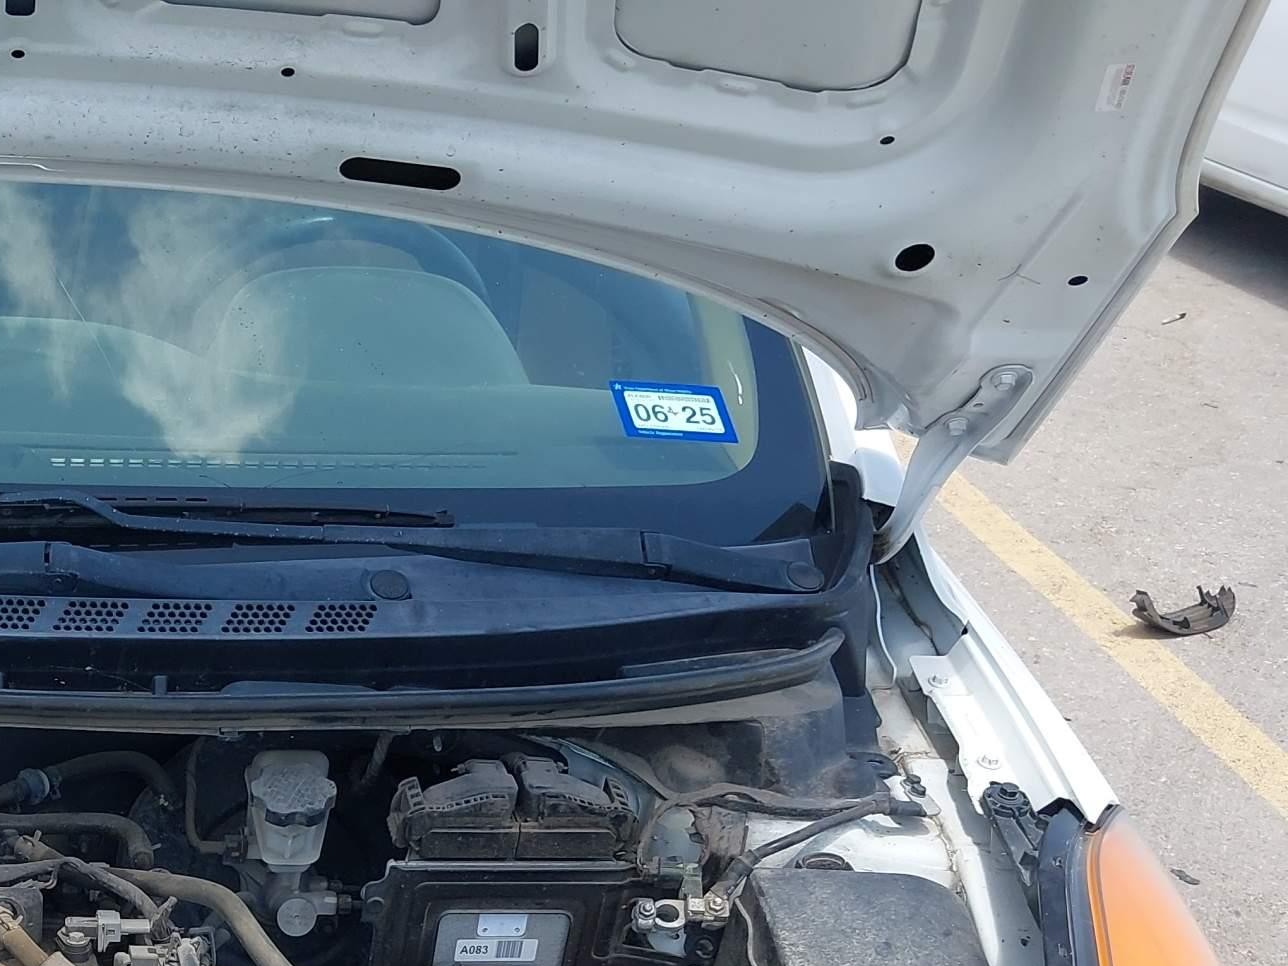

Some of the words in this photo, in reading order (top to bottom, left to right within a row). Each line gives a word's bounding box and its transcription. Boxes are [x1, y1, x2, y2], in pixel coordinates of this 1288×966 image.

[634, 403, 669, 423] 06
[681, 405, 717, 426] 25
[459, 945, 489, 955] A083
